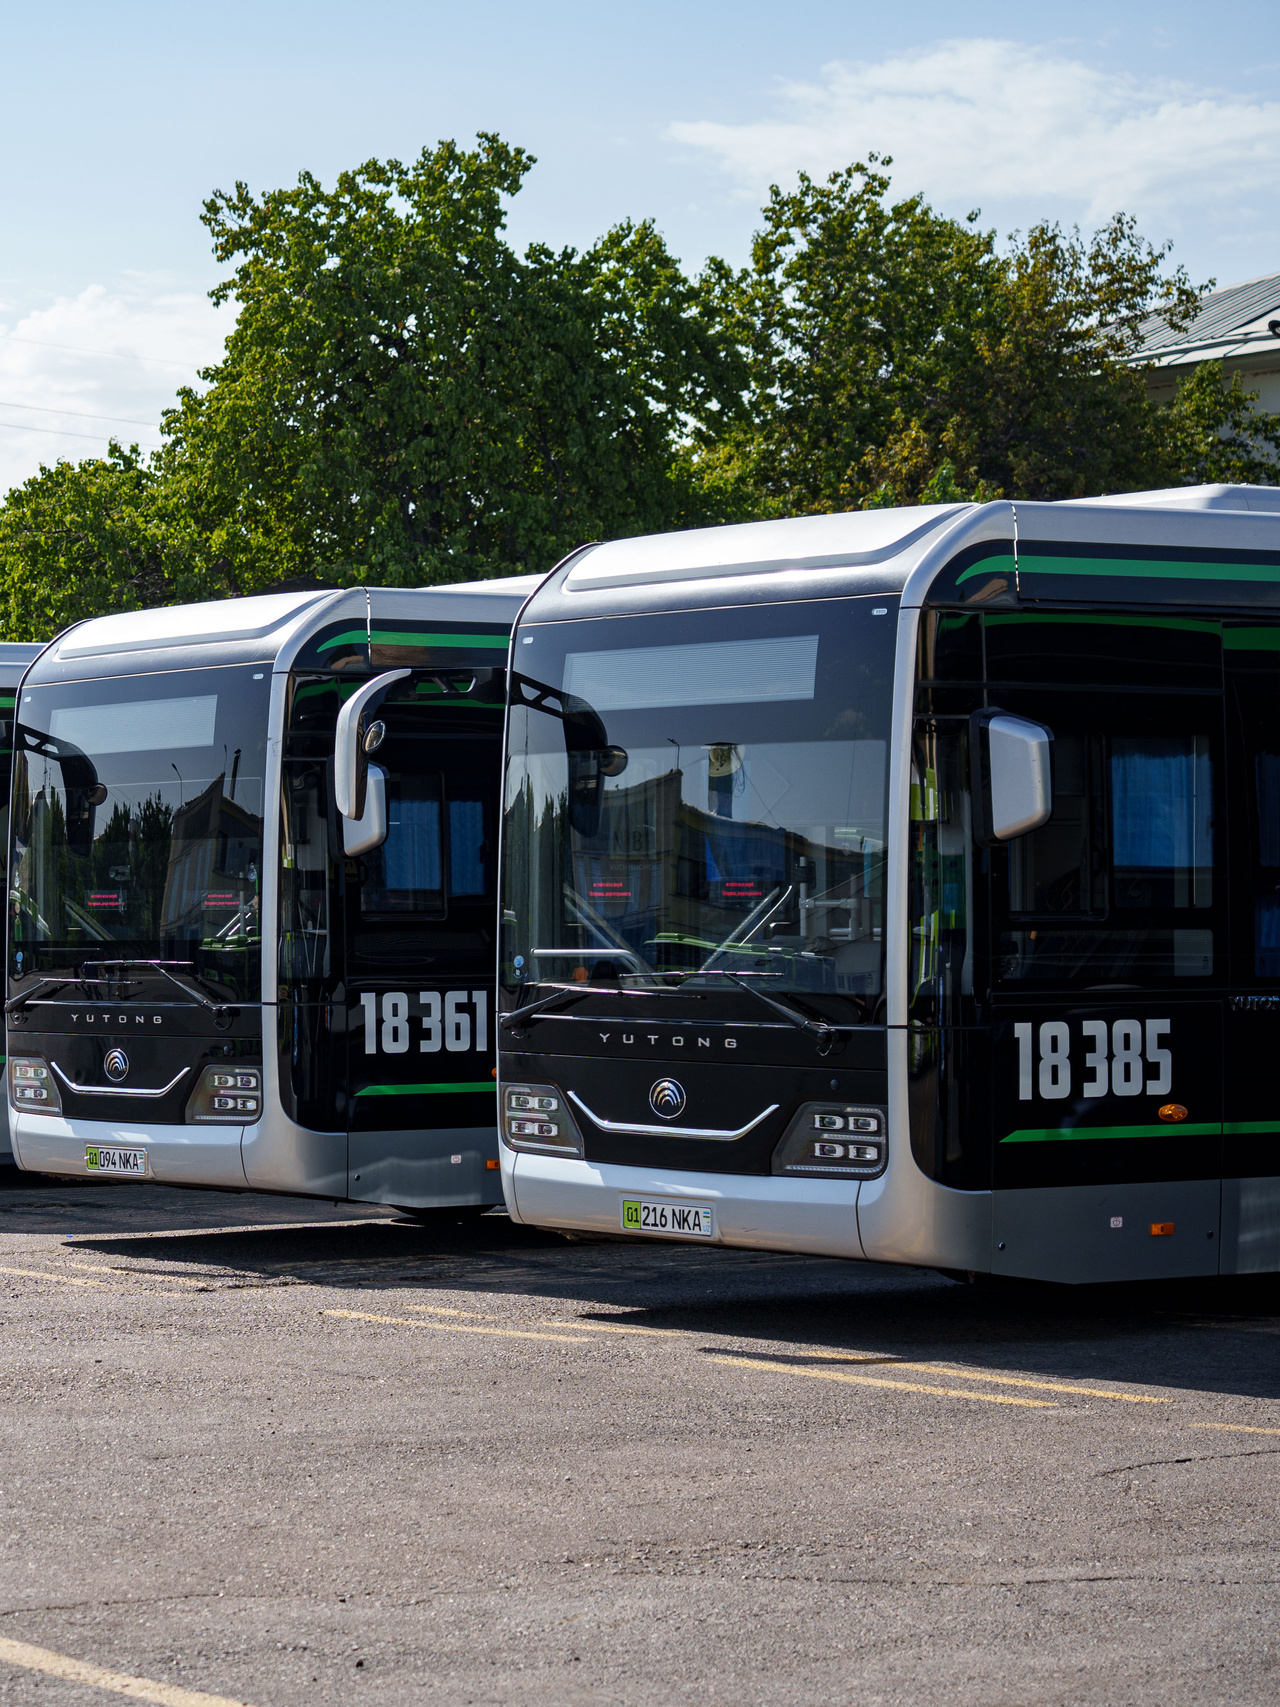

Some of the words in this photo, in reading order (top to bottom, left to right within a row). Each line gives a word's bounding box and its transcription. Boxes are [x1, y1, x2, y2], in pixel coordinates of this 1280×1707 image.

[70, 1013, 162, 1024] YUTONG
[360, 991, 409, 1054] 18
[419, 990, 487, 1052] 361
[599, 1033, 738, 1049] YUTONG
[1014, 1020, 1071, 1100] 18
[1082, 1018, 1172, 1098] 385
[89, 1152, 99, 1165] 01
[99, 1151, 117, 1169] 094
[118, 1152, 139, 1170] NKA
[626, 1206, 640, 1223] 01
[642, 1205, 668, 1228] 216
[671, 1208, 702, 1232] NKA
